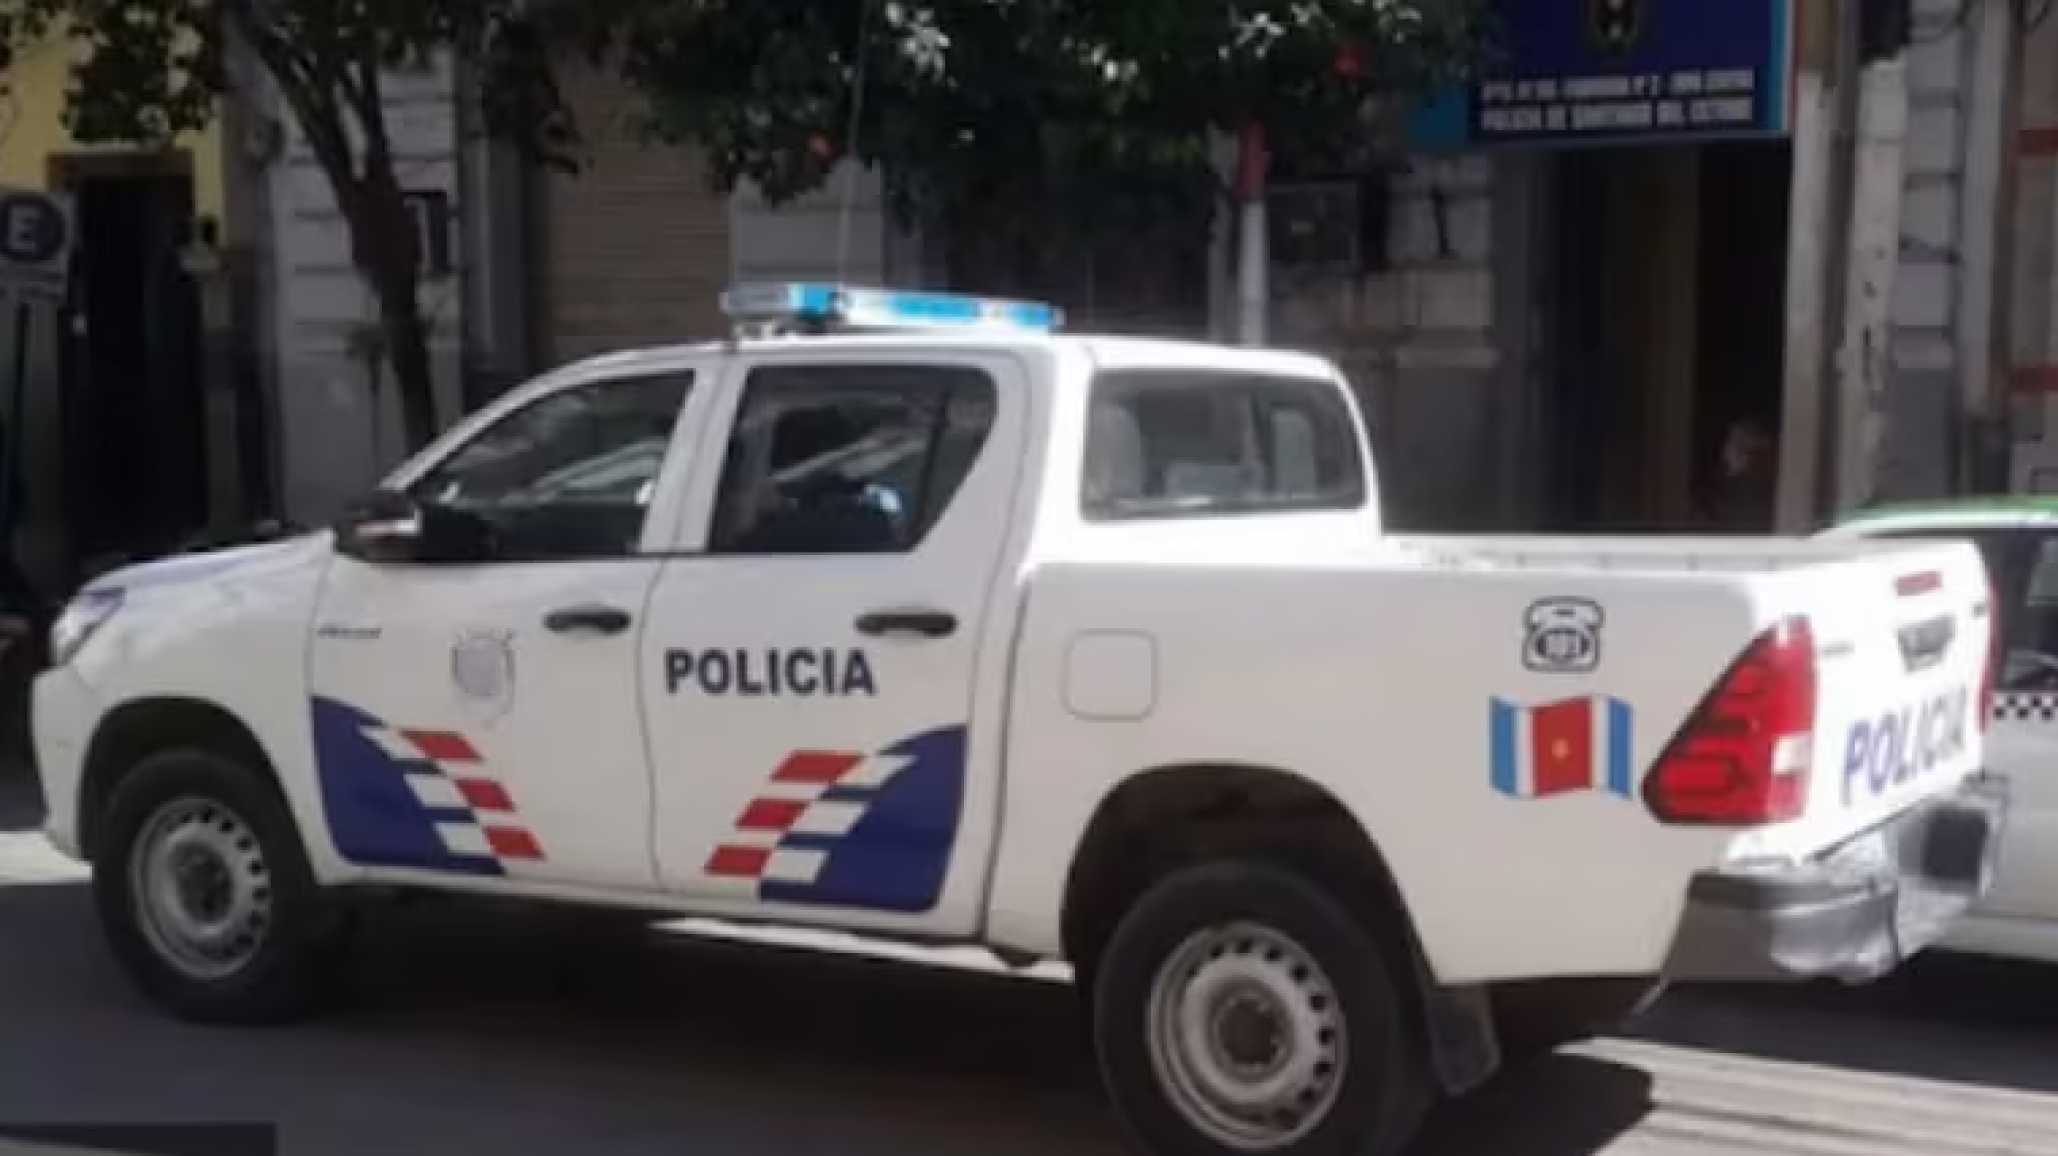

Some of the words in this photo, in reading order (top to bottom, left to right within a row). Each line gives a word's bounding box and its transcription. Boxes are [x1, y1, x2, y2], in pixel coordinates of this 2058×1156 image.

[9, 204, 39, 252] E
[664, 646, 877, 696] POLICIA
[1841, 683, 1968, 809] POLICIA
